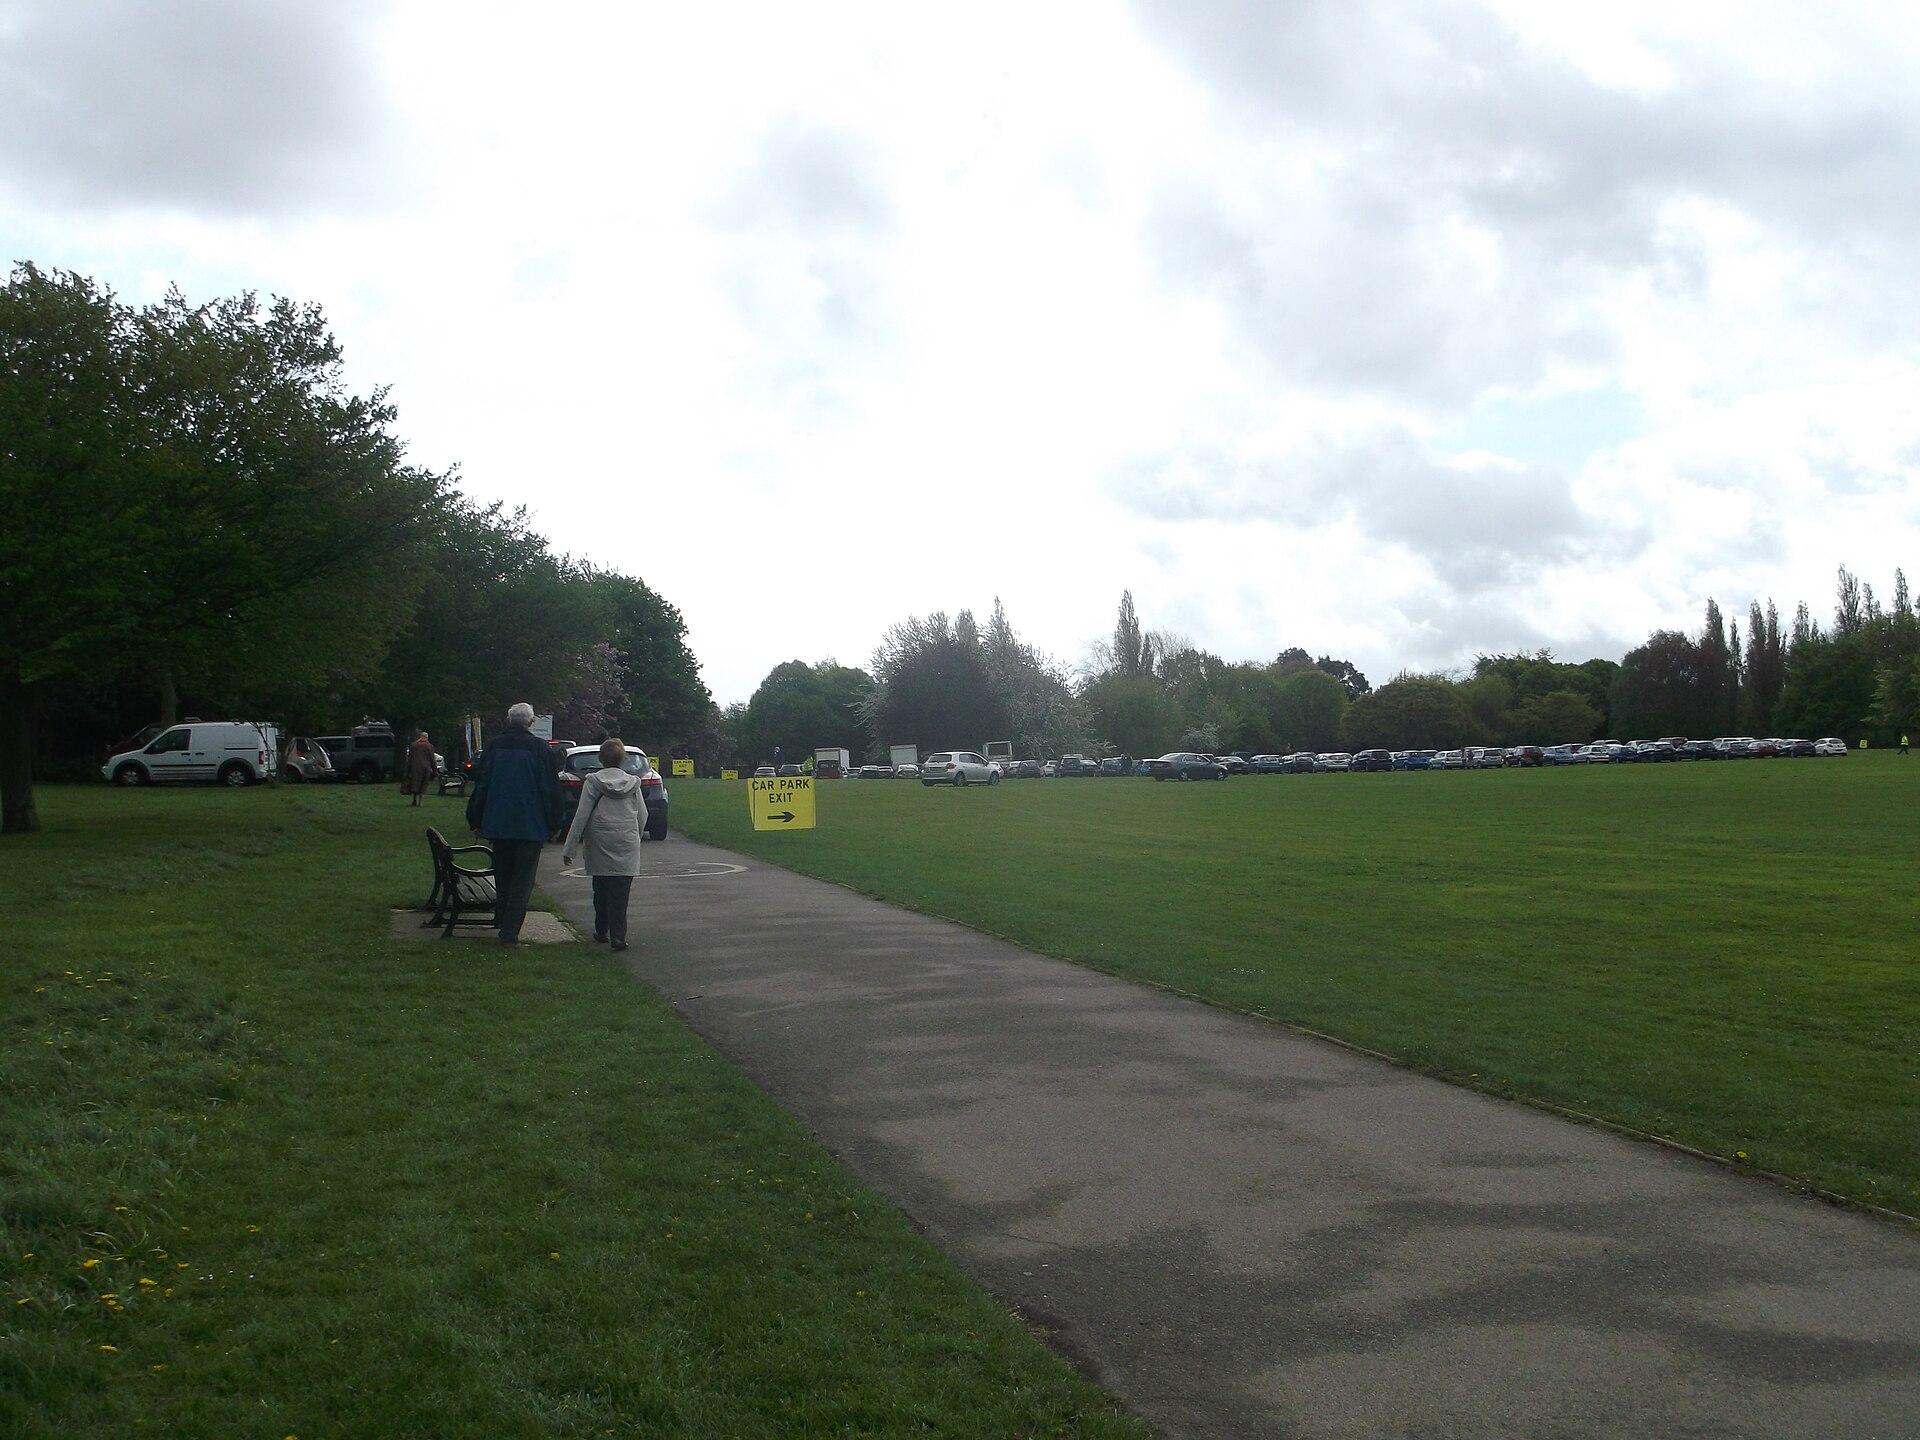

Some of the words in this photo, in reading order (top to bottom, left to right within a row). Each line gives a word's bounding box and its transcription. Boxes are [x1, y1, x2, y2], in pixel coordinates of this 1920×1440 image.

[752, 780, 774, 791] CAR
[780, 779, 810, 790] PARK
[769, 793, 793, 803] EXIT
